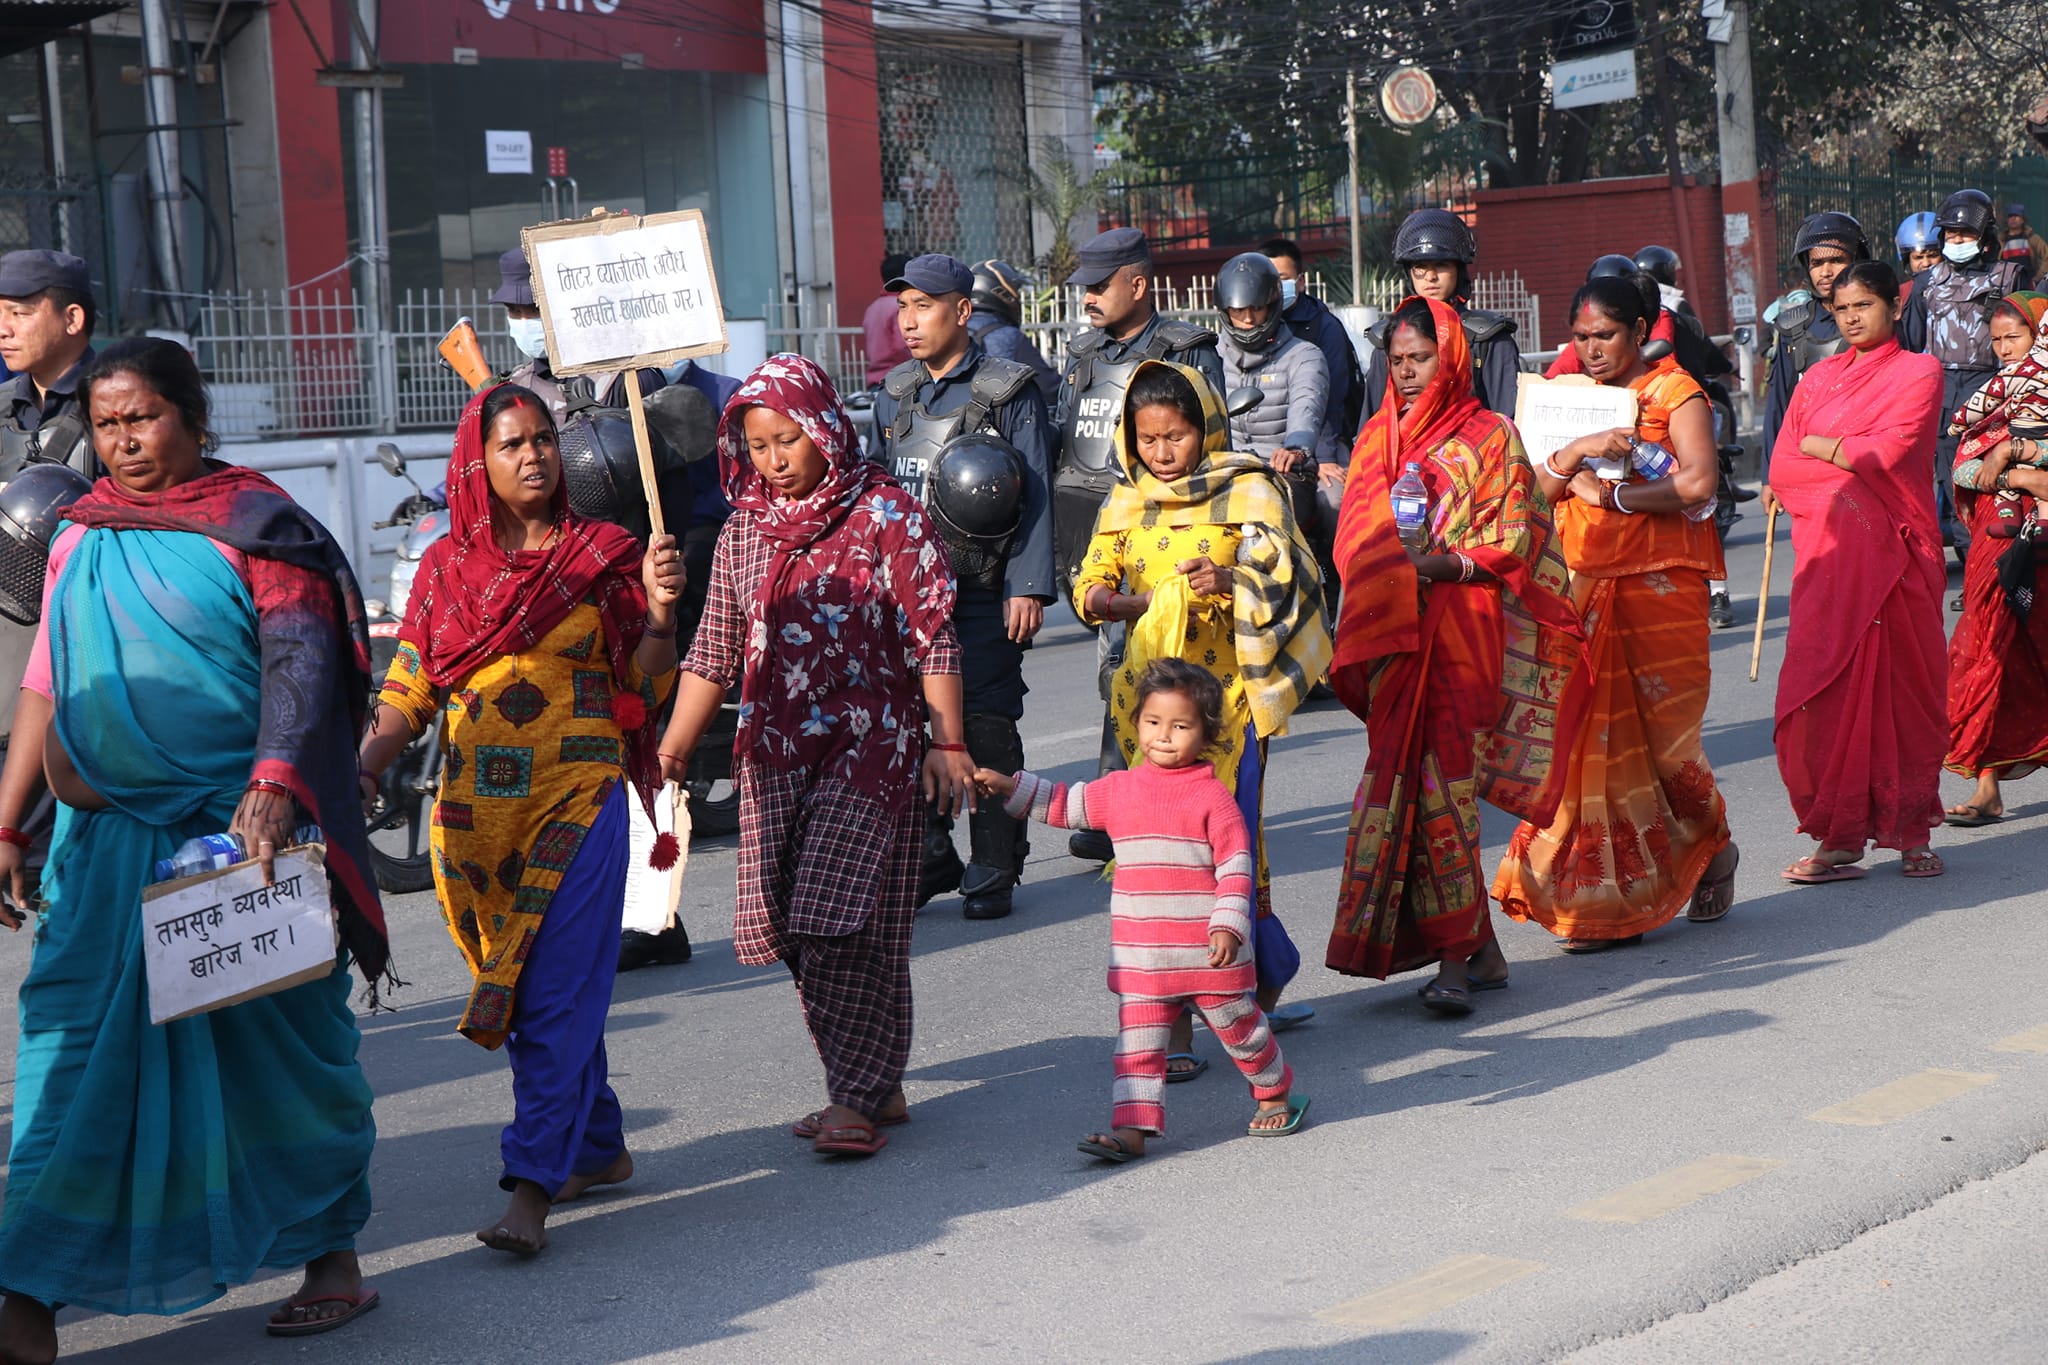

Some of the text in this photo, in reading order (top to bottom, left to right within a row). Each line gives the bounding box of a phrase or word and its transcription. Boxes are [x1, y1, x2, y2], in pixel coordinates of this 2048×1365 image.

[557, 262, 593, 292] मिटर
[653, 246, 688, 276] अवैध
[1078, 398, 1122, 418] NEPA
[1074, 420, 1114, 439] POLI
[894, 456, 929, 477] NEP
[155, 874, 302, 946] तमसुक व्यवस्था
[189, 942, 243, 979] खारेज
[251, 928, 279, 955] गर
